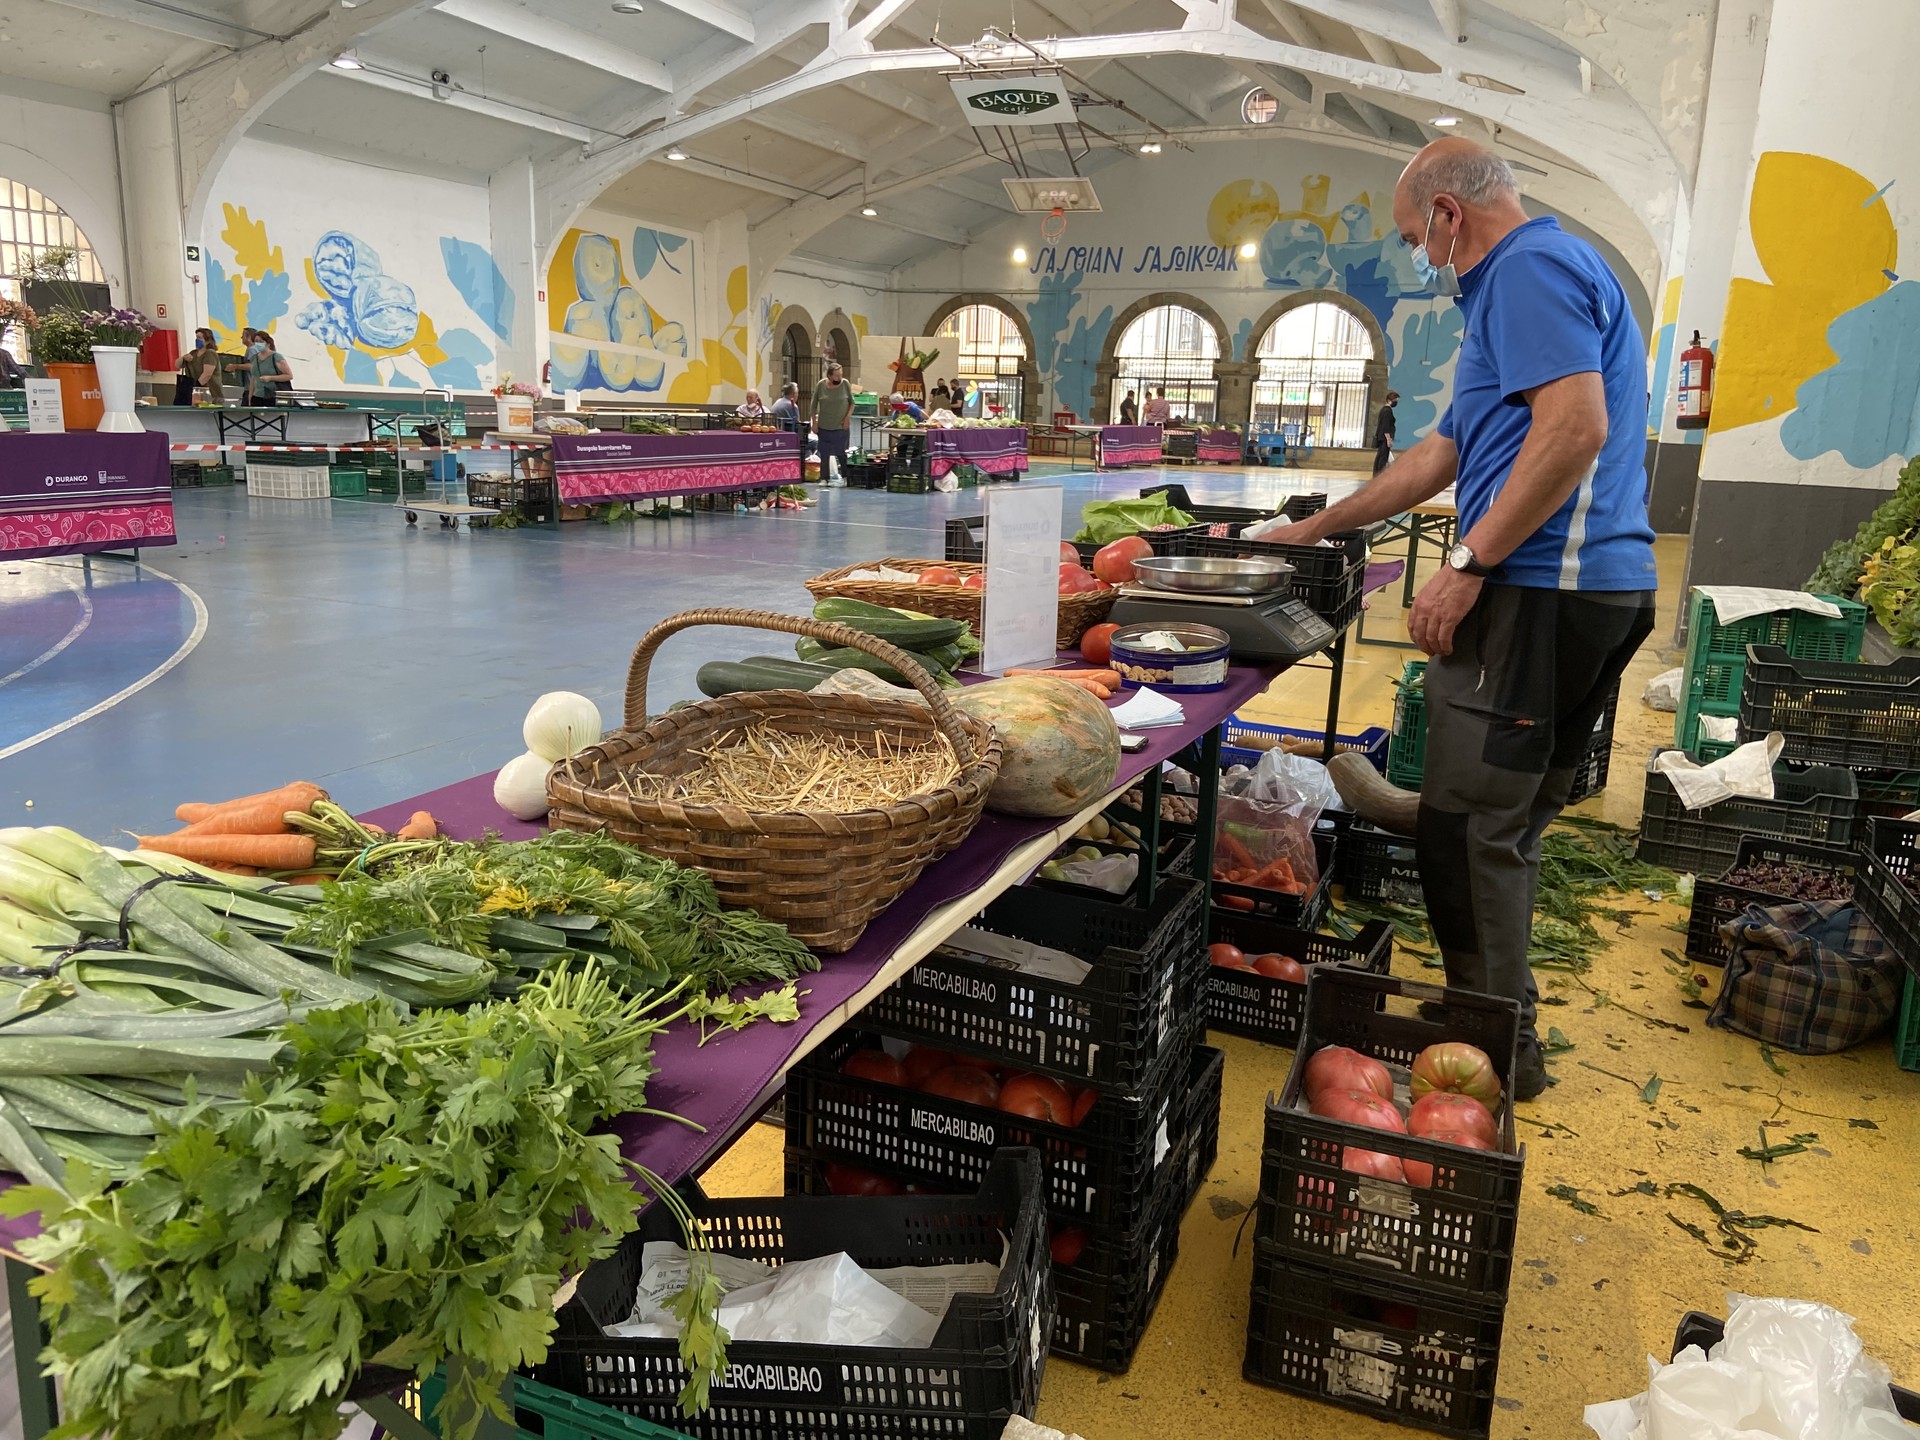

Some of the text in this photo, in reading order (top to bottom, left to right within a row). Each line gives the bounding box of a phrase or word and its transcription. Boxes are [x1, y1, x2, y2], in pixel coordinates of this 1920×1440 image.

[976, 91, 1050, 107] BAQUÉ
[55, 475, 88, 483] DURANGO
[913, 965, 997, 1003] MERCABILBAO
[1207, 977, 1260, 1002] ERCABILBAO
[911, 1108, 995, 1146] MERCABILBAO
[710, 1363, 822, 1392] MERCABILBAO
